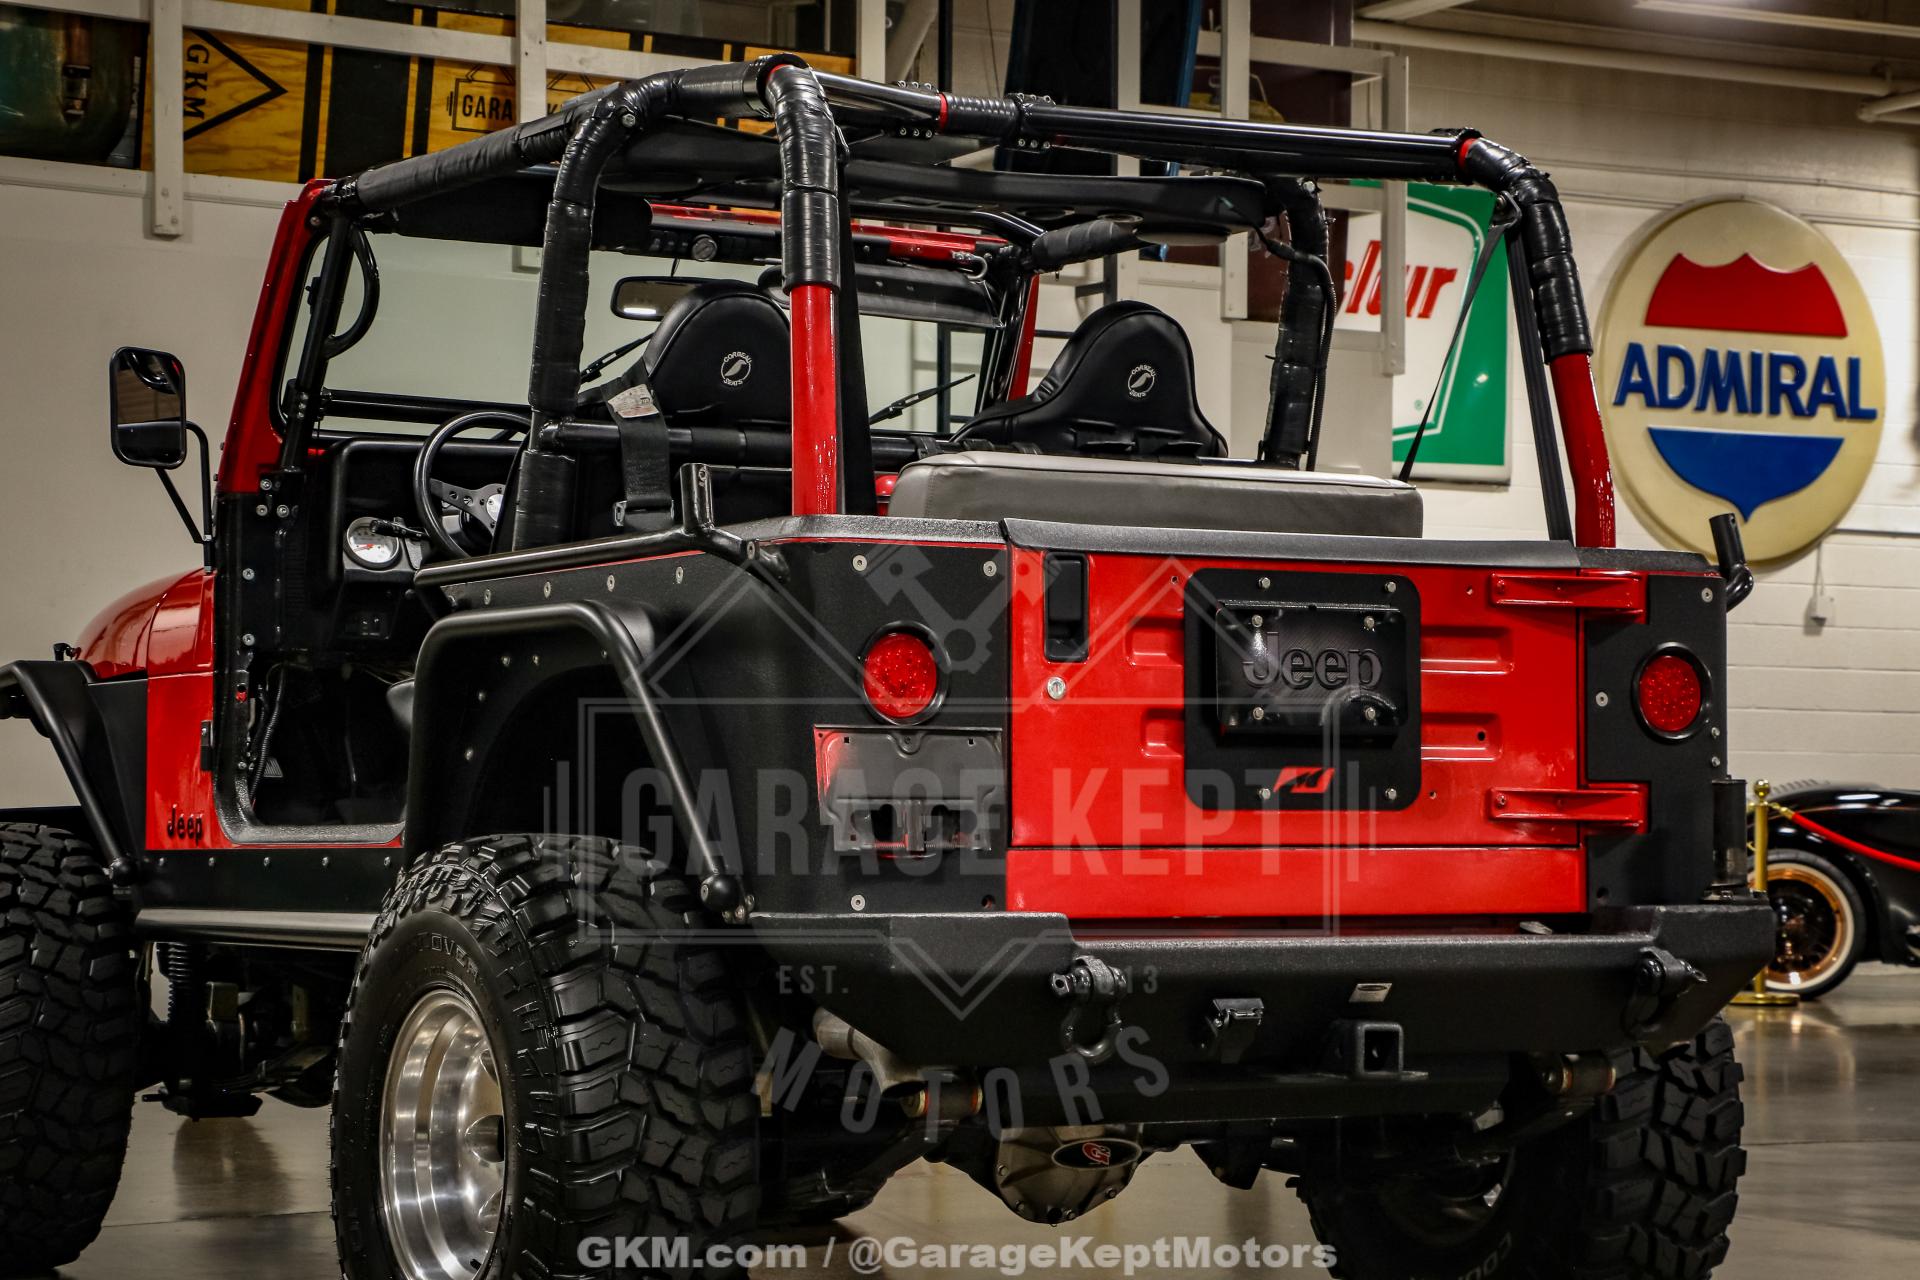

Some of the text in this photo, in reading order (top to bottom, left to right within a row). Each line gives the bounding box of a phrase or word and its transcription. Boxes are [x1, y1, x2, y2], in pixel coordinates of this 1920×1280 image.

[182, 44, 209, 120] GKM
[723, 351, 753, 365] CORBEAU
[1613, 342, 1878, 419] ADMIRAL
[1243, 631, 1382, 694] Jeep
[167, 803, 205, 847] Jeep
